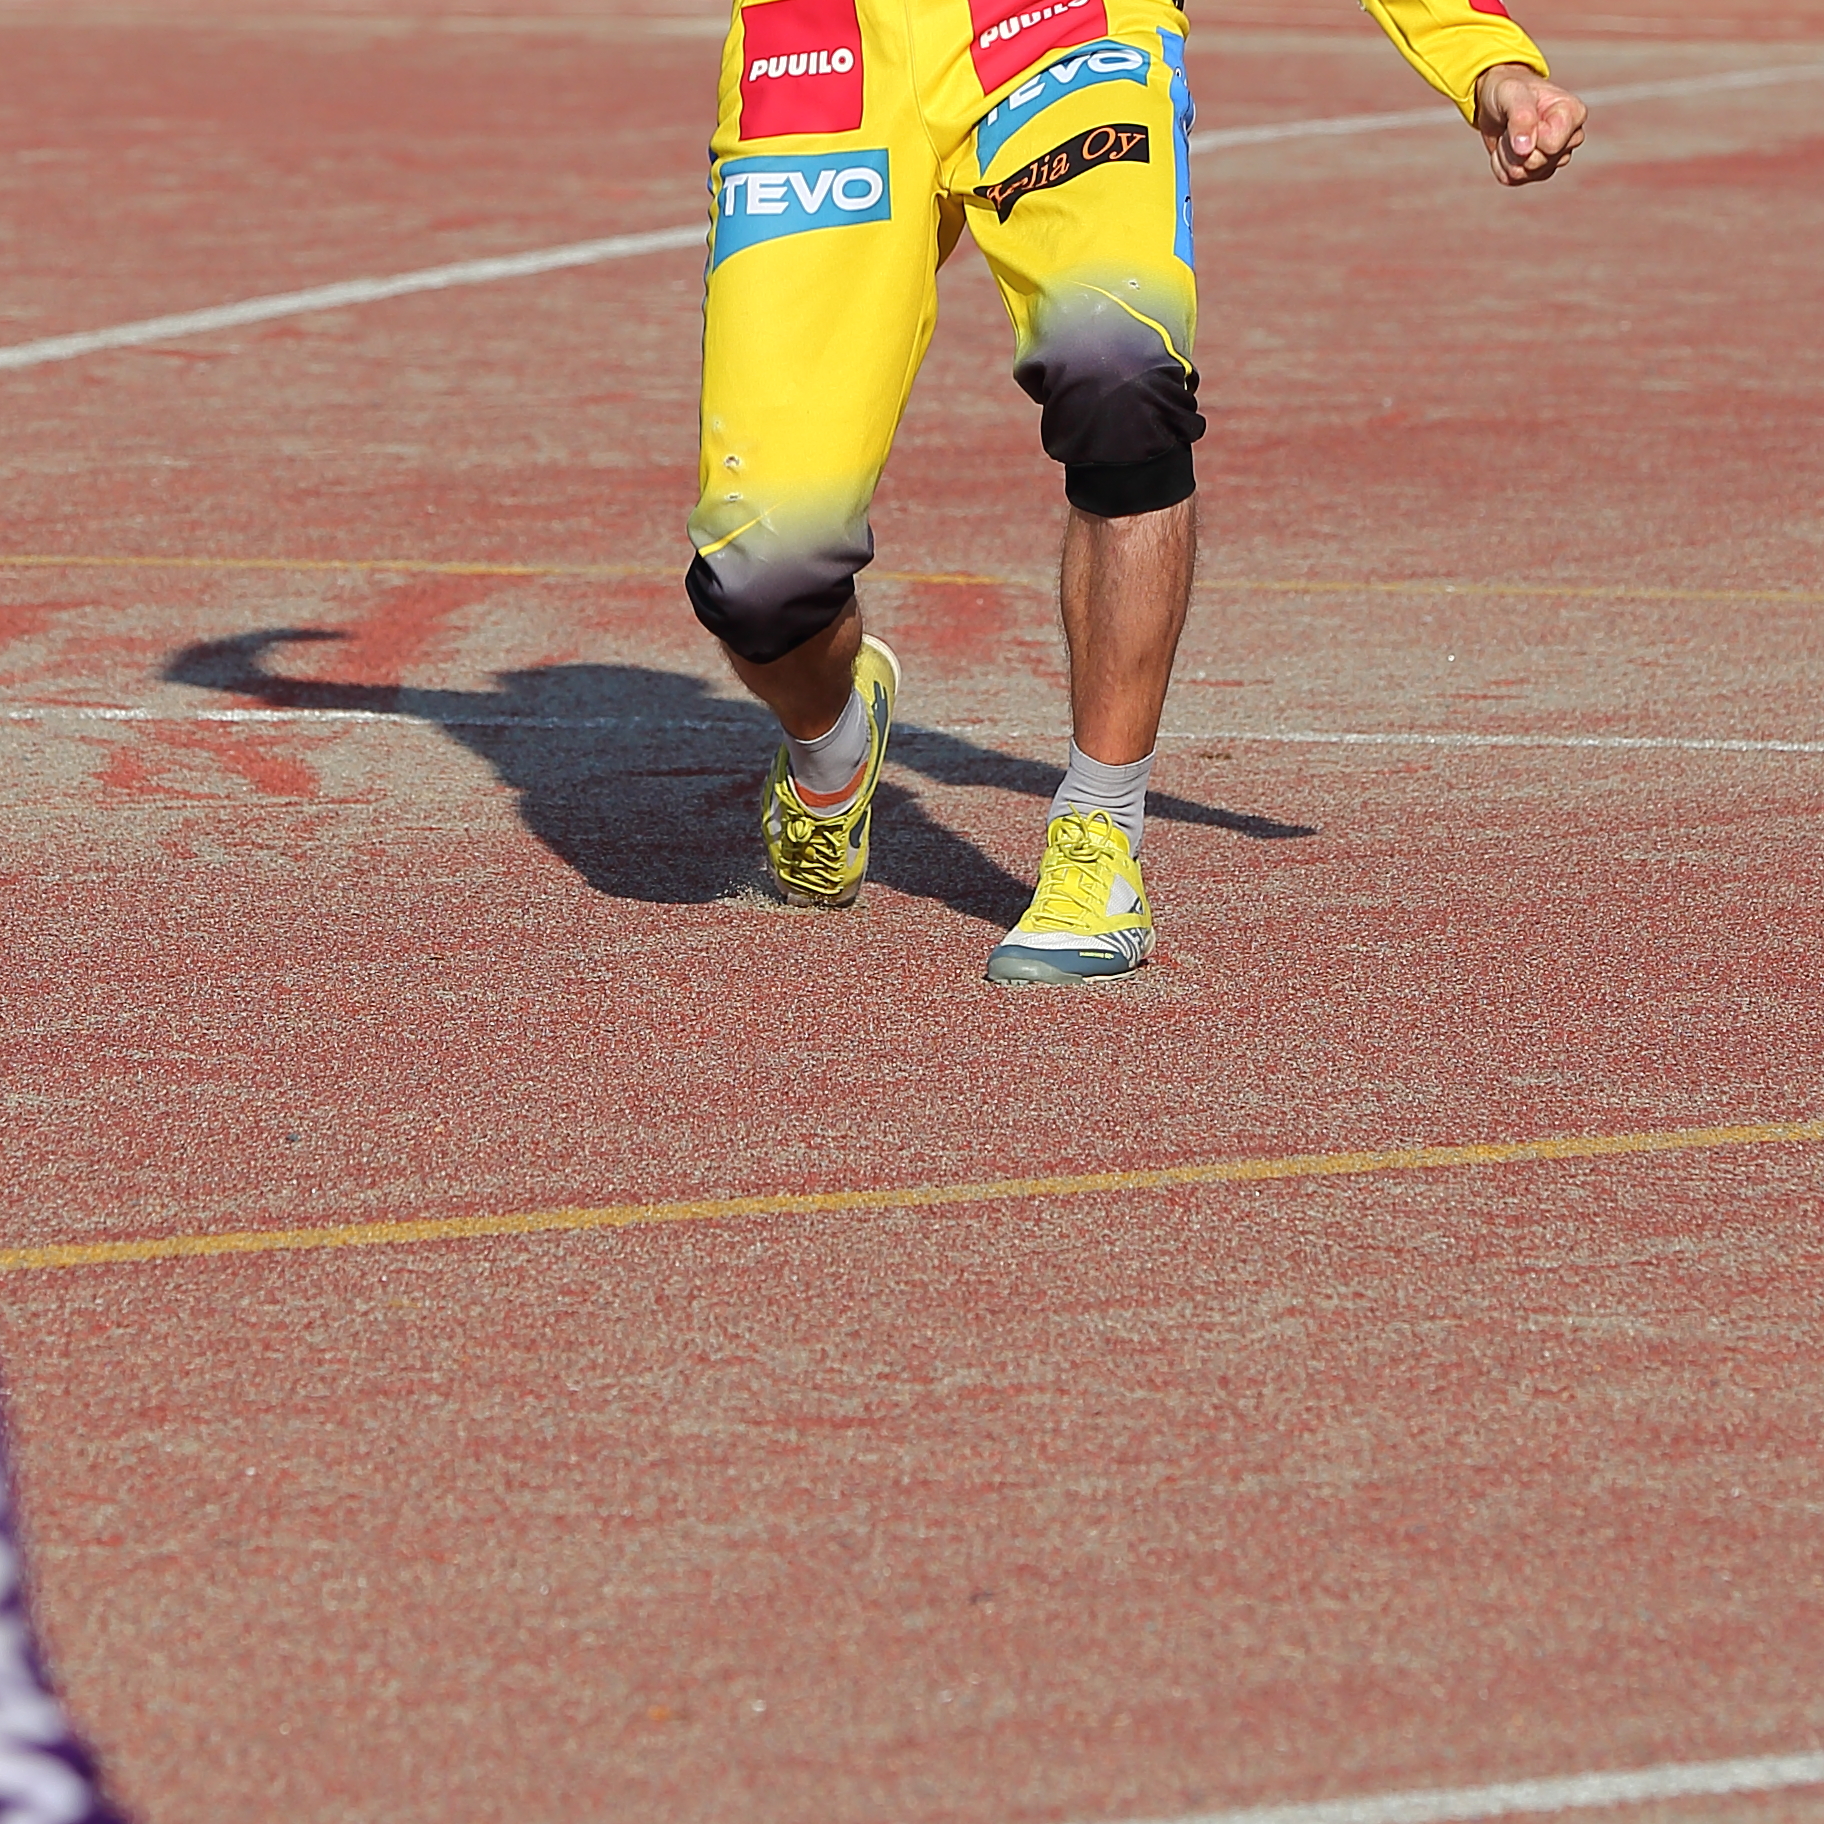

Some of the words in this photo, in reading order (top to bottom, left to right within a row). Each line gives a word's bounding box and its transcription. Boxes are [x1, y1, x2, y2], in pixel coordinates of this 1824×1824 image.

[747, 47, 855, 83] PUUILO
[1081, 126, 1146, 161] Oy
[721, 167, 886, 218] TEVO
